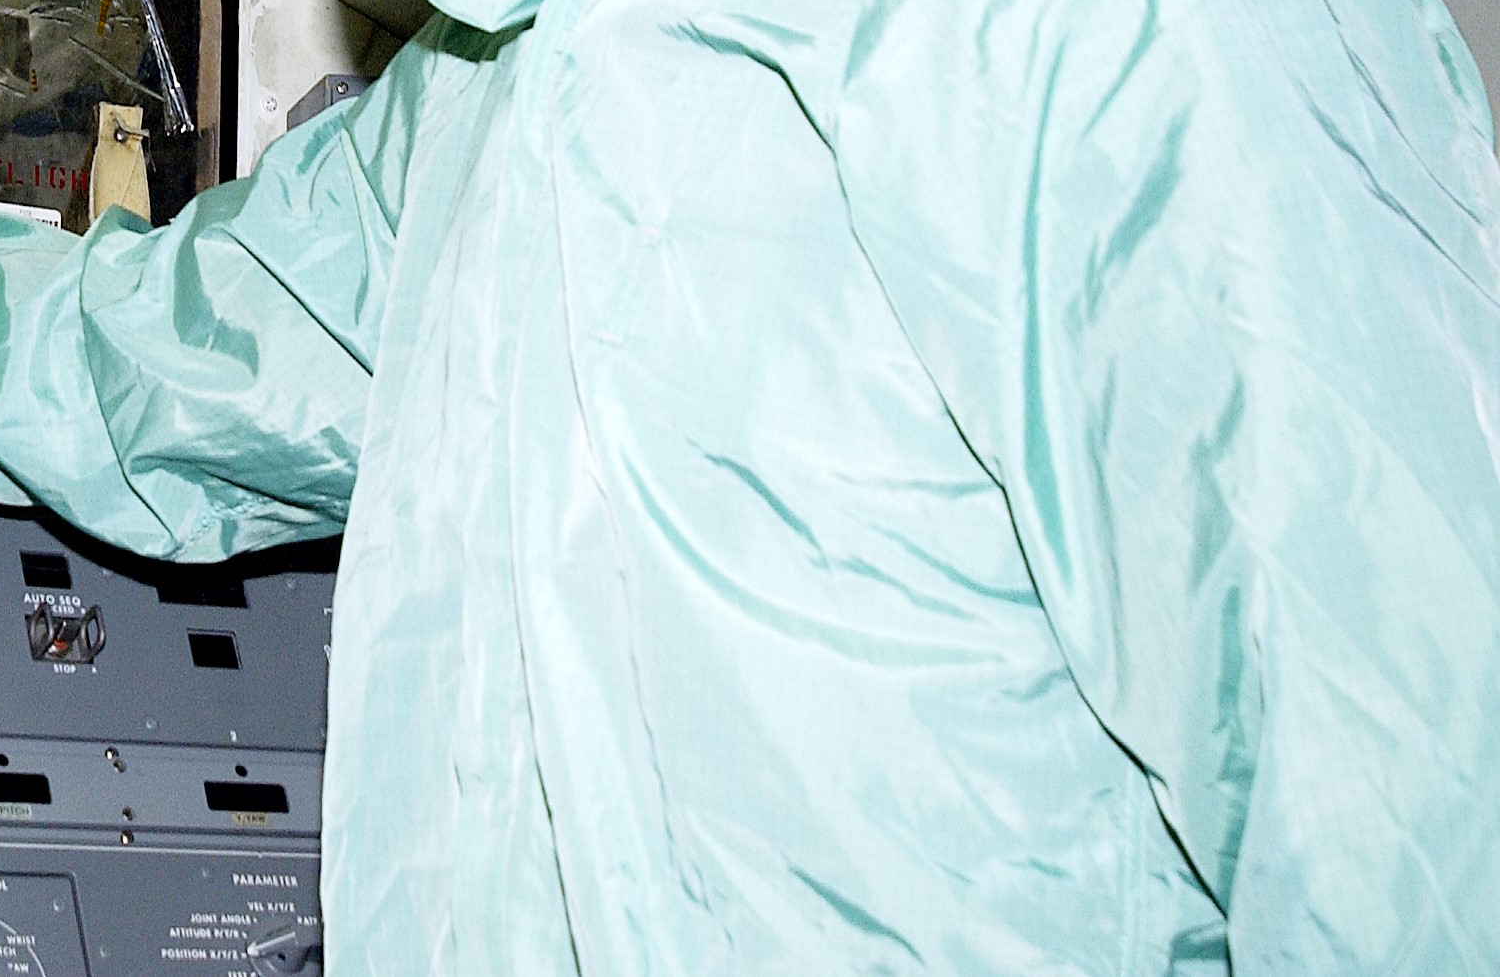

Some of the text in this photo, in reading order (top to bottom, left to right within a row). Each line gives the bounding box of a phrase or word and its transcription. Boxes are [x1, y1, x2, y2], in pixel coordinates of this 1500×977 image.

[23, 593, 82, 608] AUTO SEQ
[53, 663, 77, 674] STOP
[232, 873, 299, 887] PARAMETER
[247, 901, 264, 912] VEL
[190, 913, 252, 925] JOINT ANGLE
[169, 927, 211, 938] ATTITUDE
[6, 935, 36, 946] WRIST
[161, 948, 207, 959] POSITION
